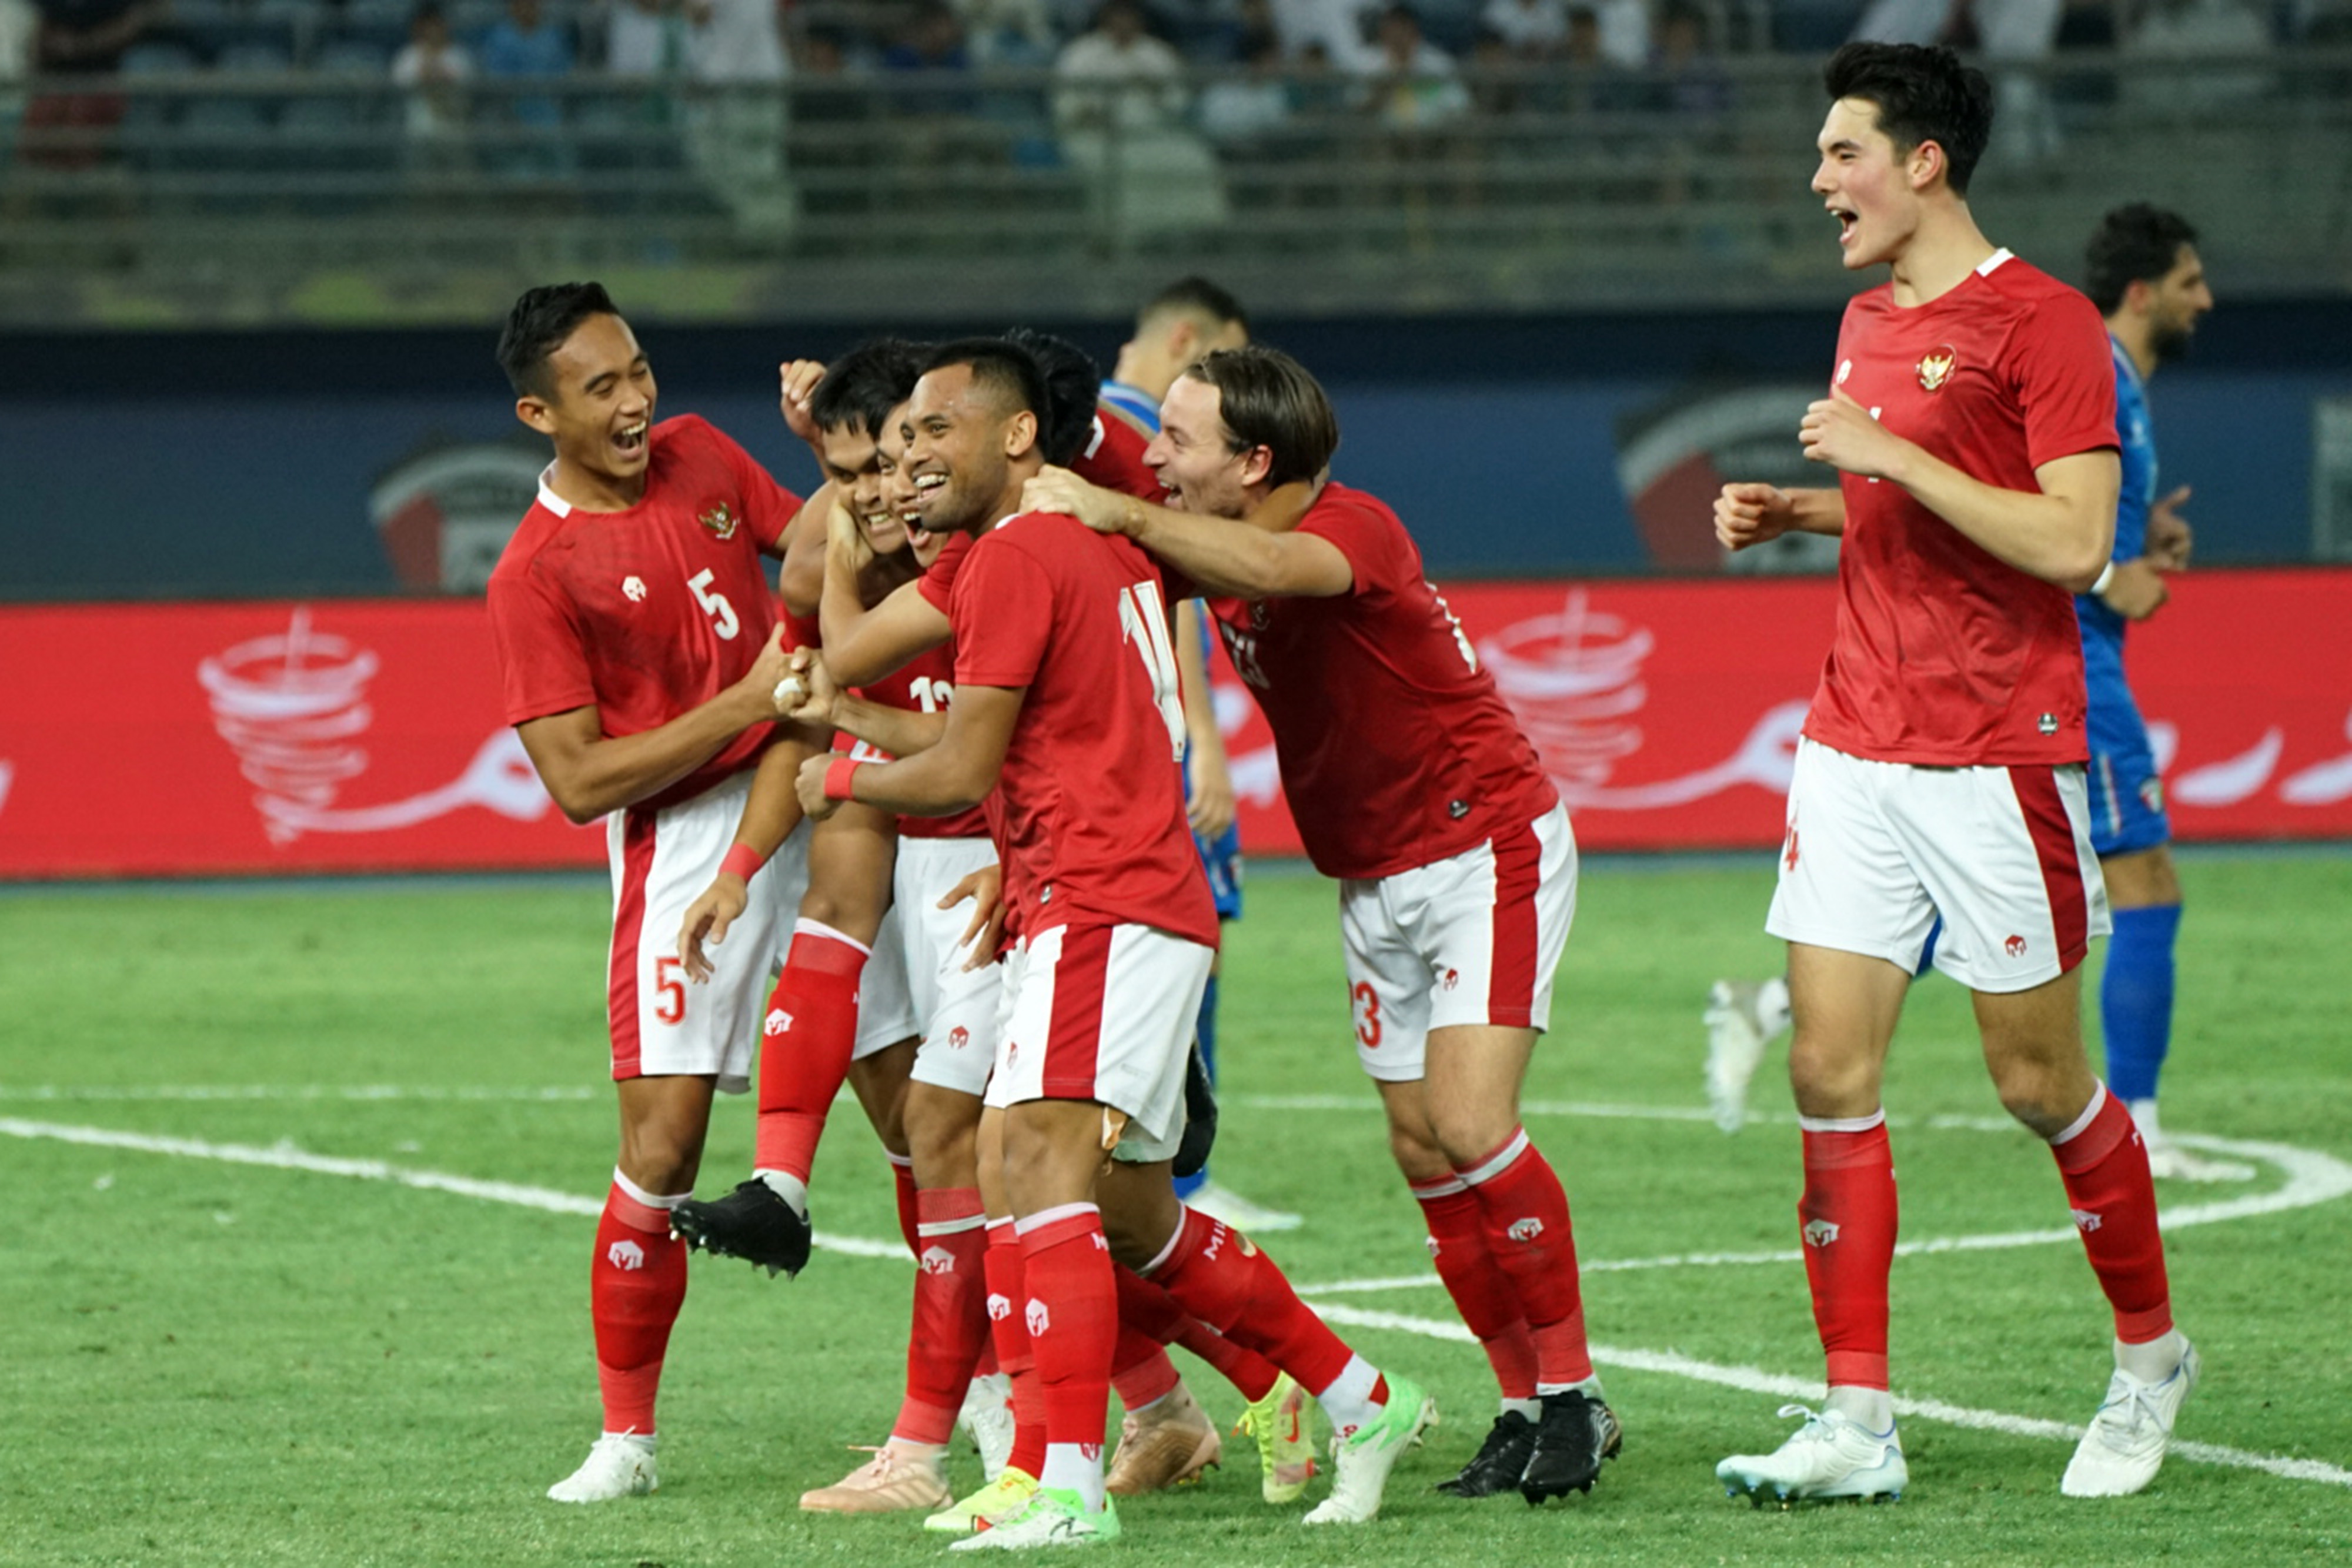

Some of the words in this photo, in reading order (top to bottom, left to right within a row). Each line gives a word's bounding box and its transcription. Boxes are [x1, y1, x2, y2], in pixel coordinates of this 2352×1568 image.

[686, 567, 740, 640] 5
[656, 956, 685, 1026] 5
[1348, 980, 1381, 1049] 3
